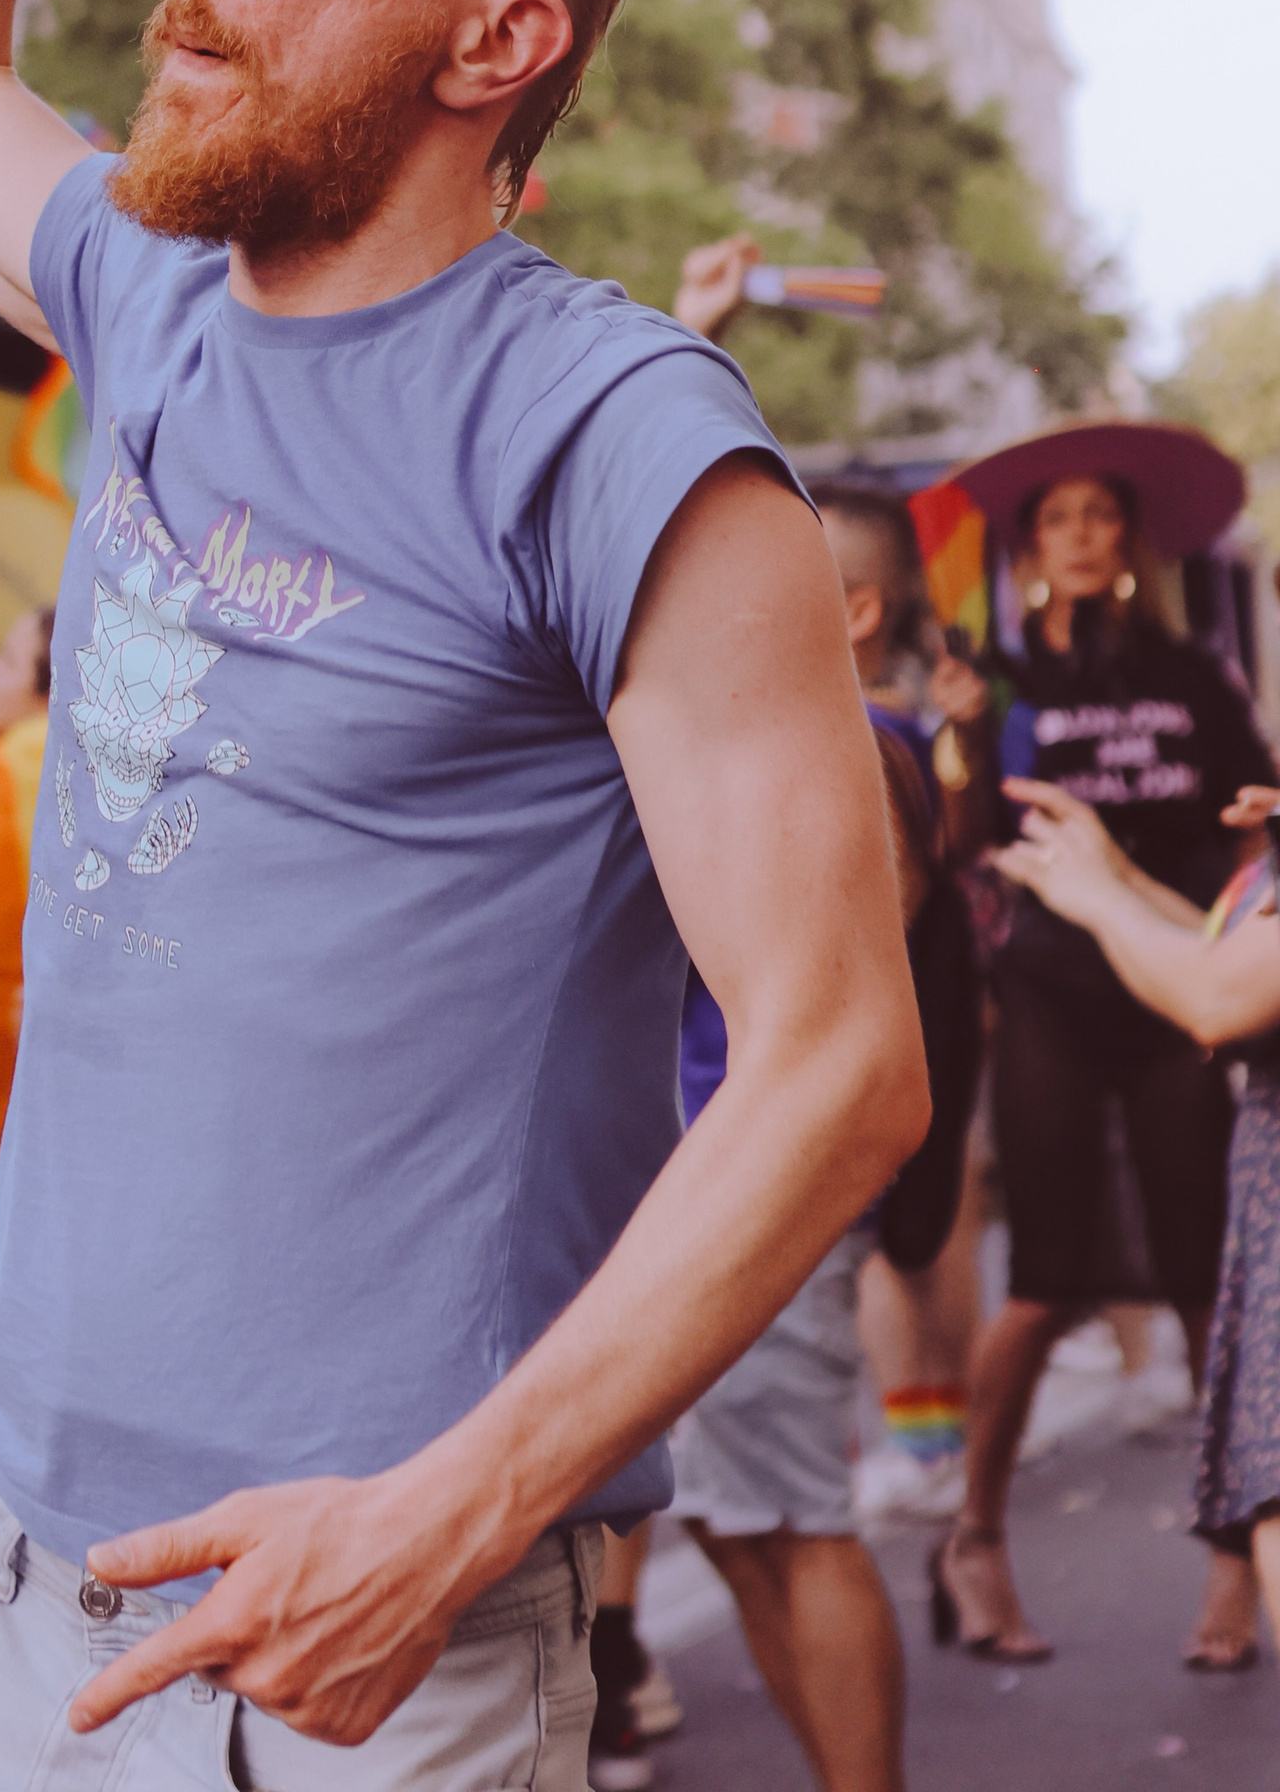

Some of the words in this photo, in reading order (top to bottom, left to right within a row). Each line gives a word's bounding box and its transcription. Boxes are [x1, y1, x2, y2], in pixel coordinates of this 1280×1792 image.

[29, 872, 59, 917] COME
[63, 903, 105, 940] GET
[122, 925, 182, 969] SOME
